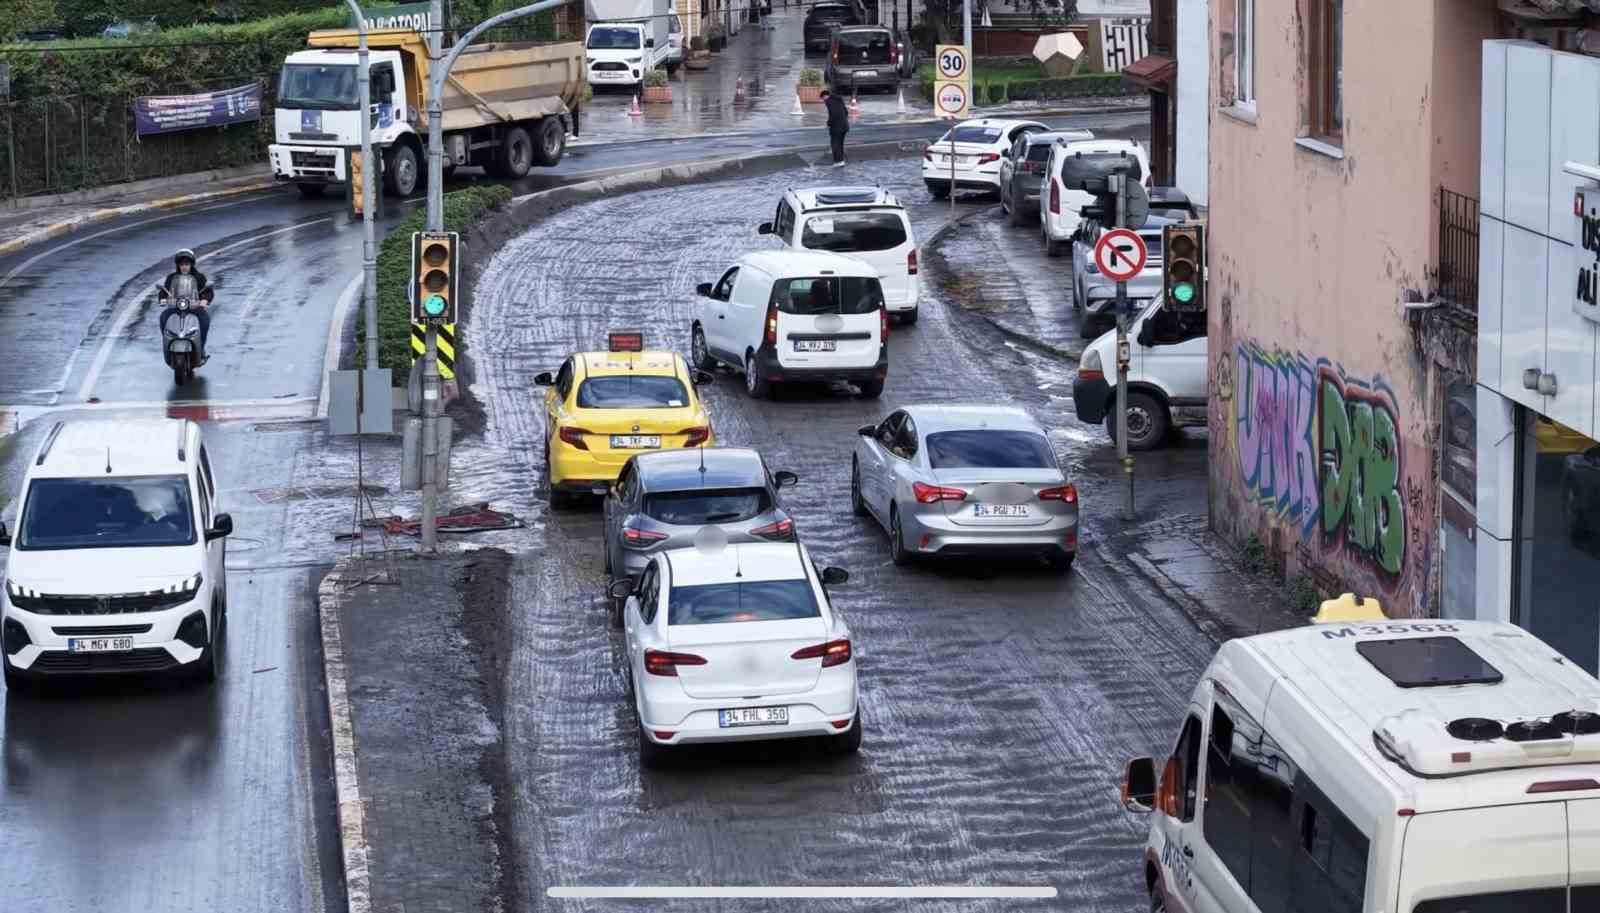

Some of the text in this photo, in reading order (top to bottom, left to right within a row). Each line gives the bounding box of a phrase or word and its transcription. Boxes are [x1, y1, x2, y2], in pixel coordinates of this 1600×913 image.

[943, 55, 962, 70] 30
[1321, 623, 1459, 639] M3568
[76, 640, 86, 650] 34
[91, 639, 109, 649] MGV
[726, 708, 785, 721] 34 FHL 350
